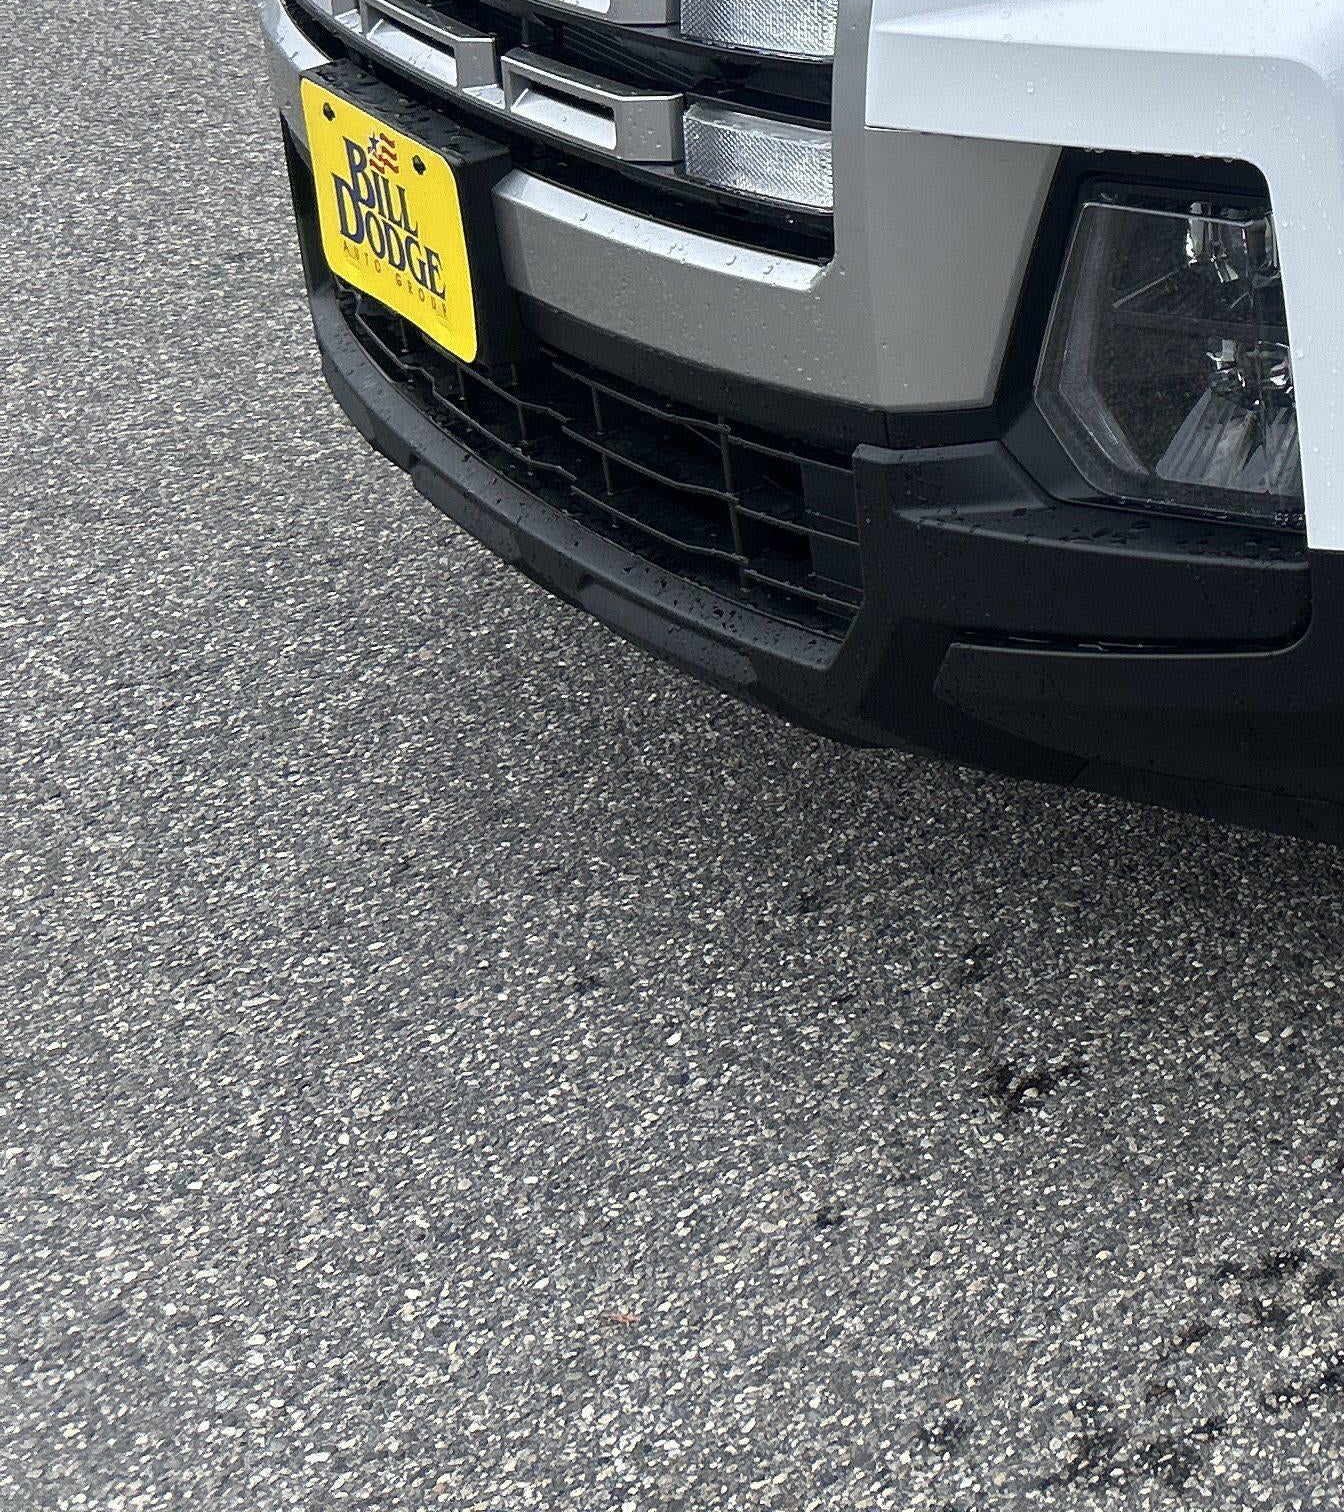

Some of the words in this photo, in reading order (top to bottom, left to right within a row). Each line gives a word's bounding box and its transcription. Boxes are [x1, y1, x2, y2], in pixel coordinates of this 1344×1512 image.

[331, 172, 447, 301] DODGE
[342, 135, 419, 239] BILL
[343, 239, 382, 274] AUTO
[395, 272, 448, 319] GROUP
